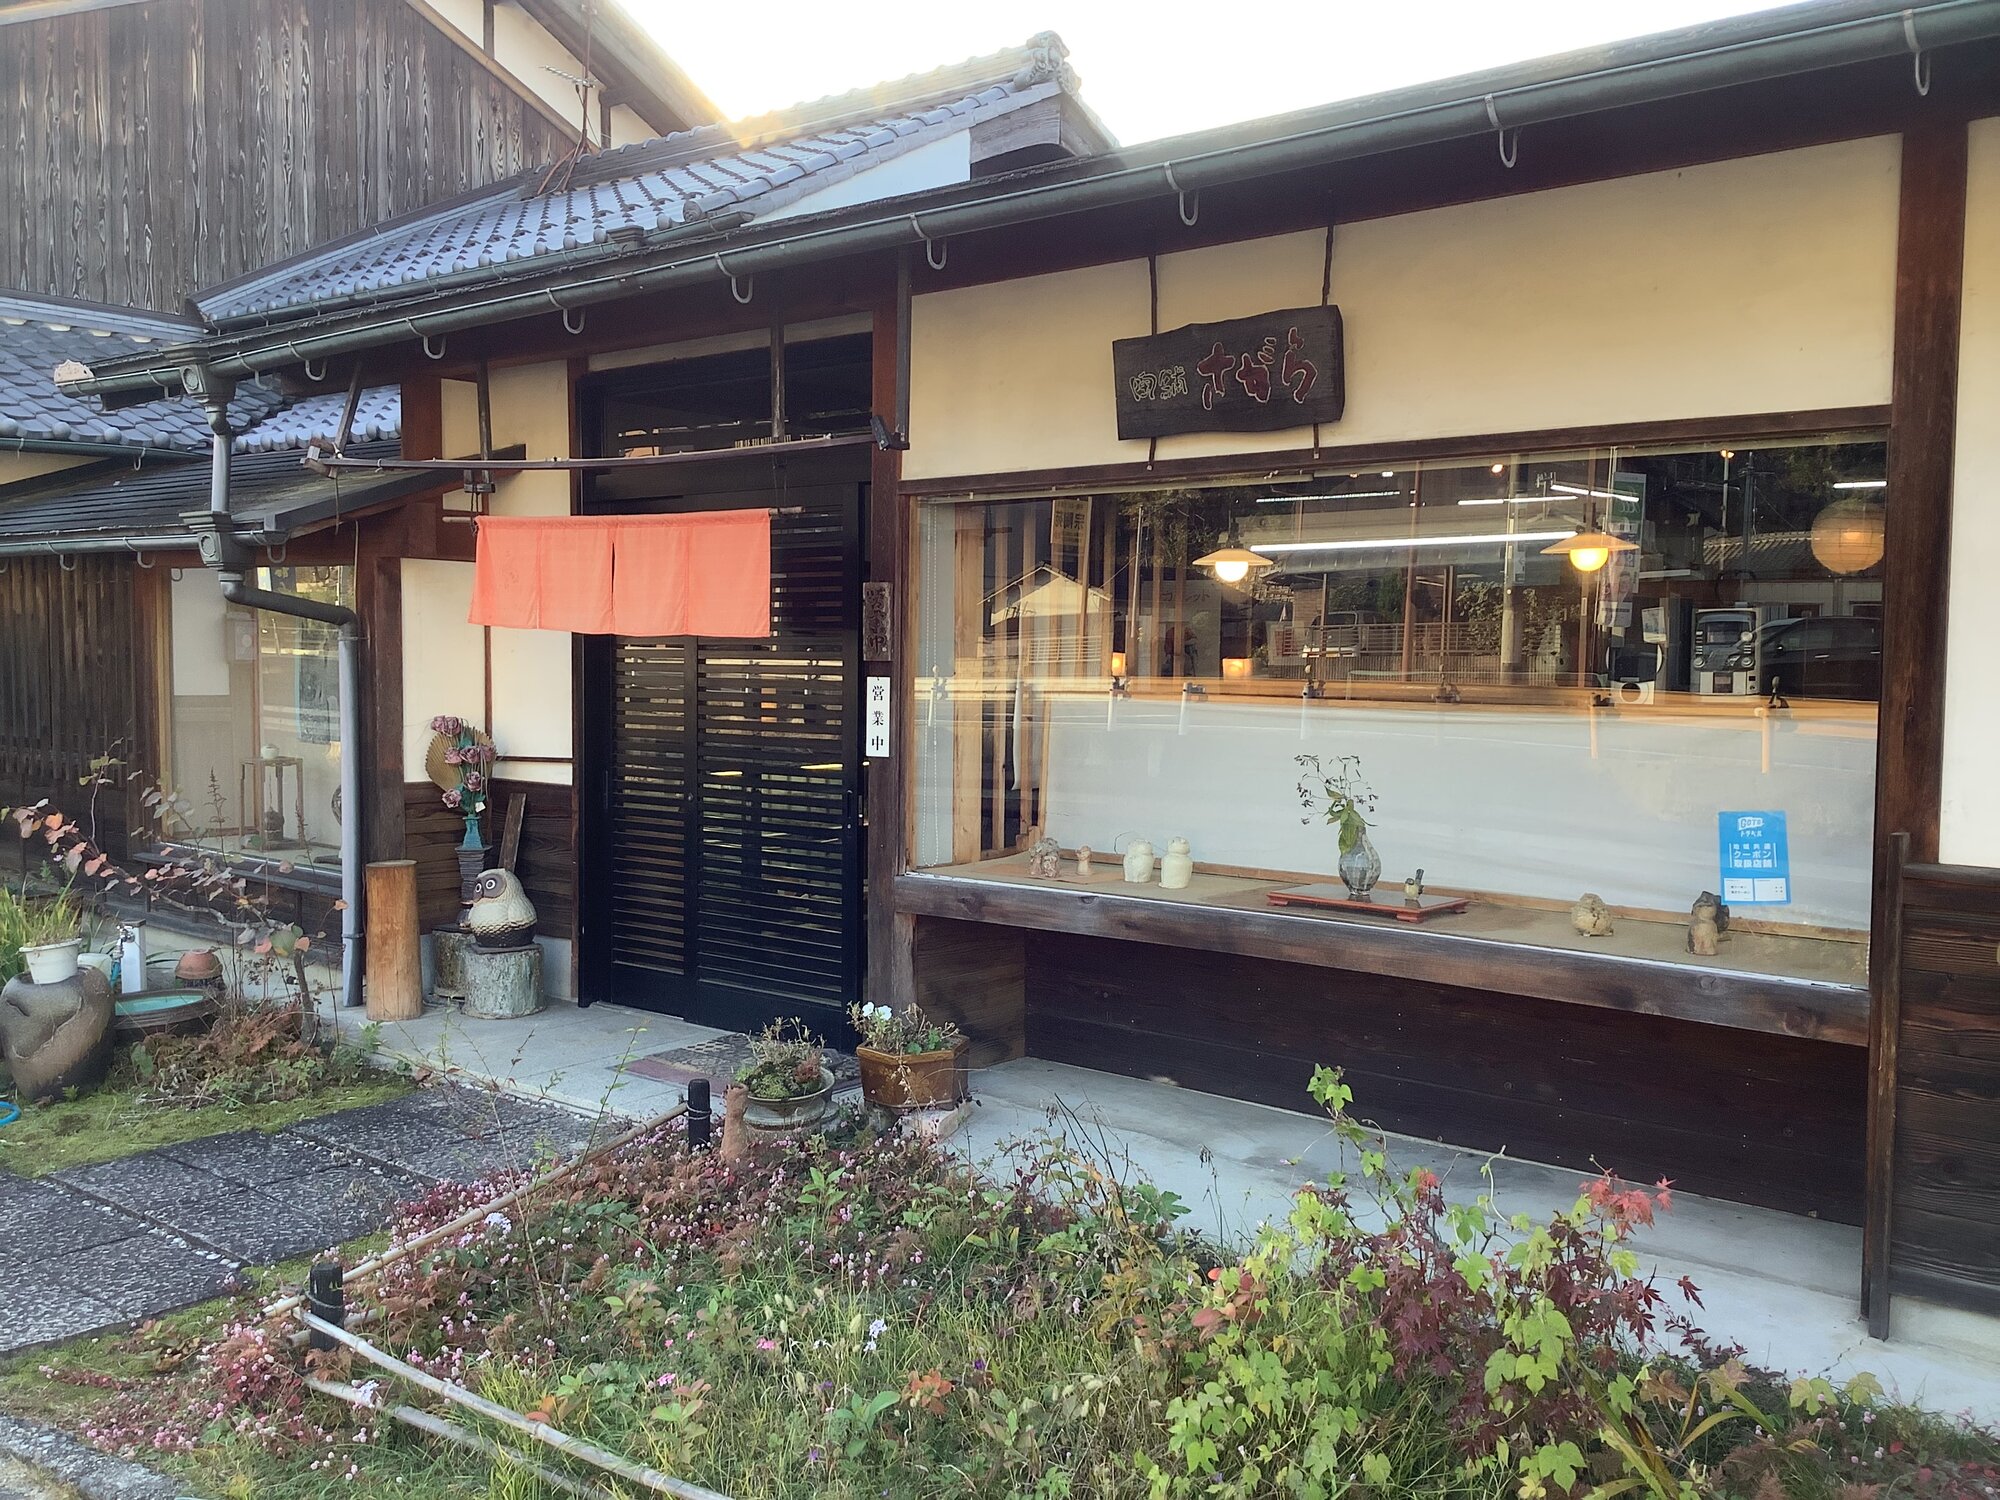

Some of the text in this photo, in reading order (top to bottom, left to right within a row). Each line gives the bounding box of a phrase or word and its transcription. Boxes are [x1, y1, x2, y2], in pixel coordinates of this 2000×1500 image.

[871, 684, 885, 751] 営業中
[1733, 850, 1772, 859] クーポン
